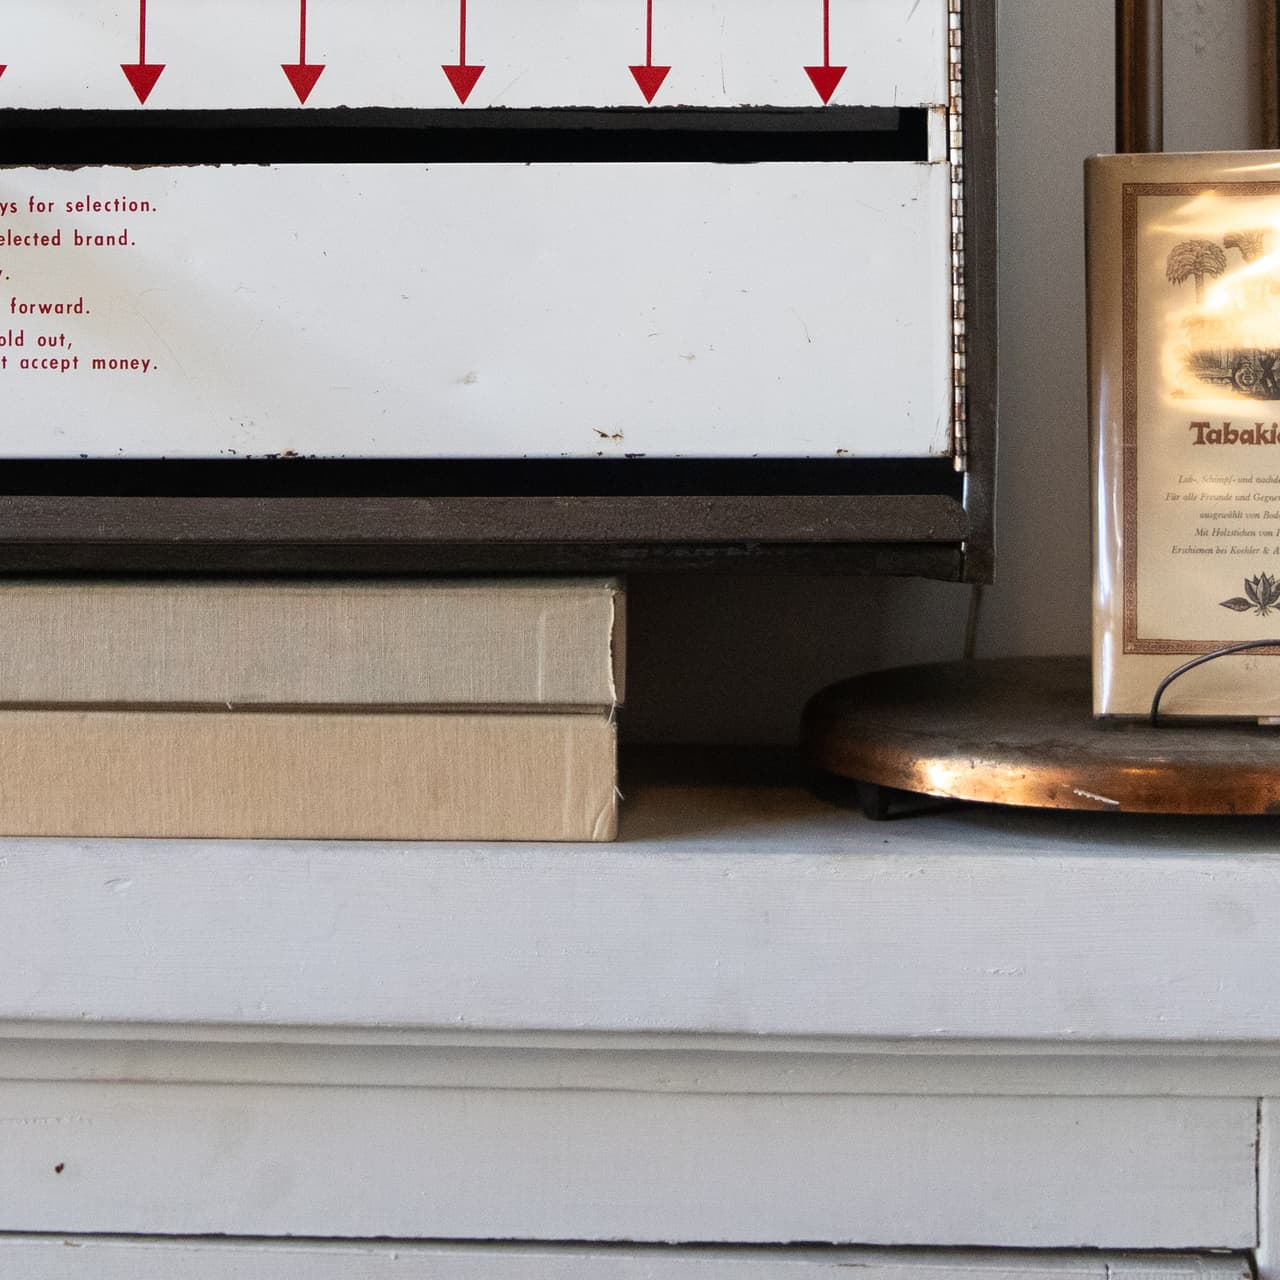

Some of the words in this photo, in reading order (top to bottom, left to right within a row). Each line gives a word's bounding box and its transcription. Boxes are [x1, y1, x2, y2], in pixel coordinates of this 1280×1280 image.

[29, 196, 54, 212] for
[66, 195, 156, 212] selection.
[74, 229, 135, 246] brand.
[11, 297, 90, 314] forward.
[38, 334, 72, 350] out,
[20, 356, 78, 373] accept
[93, 359, 157, 373] money.
